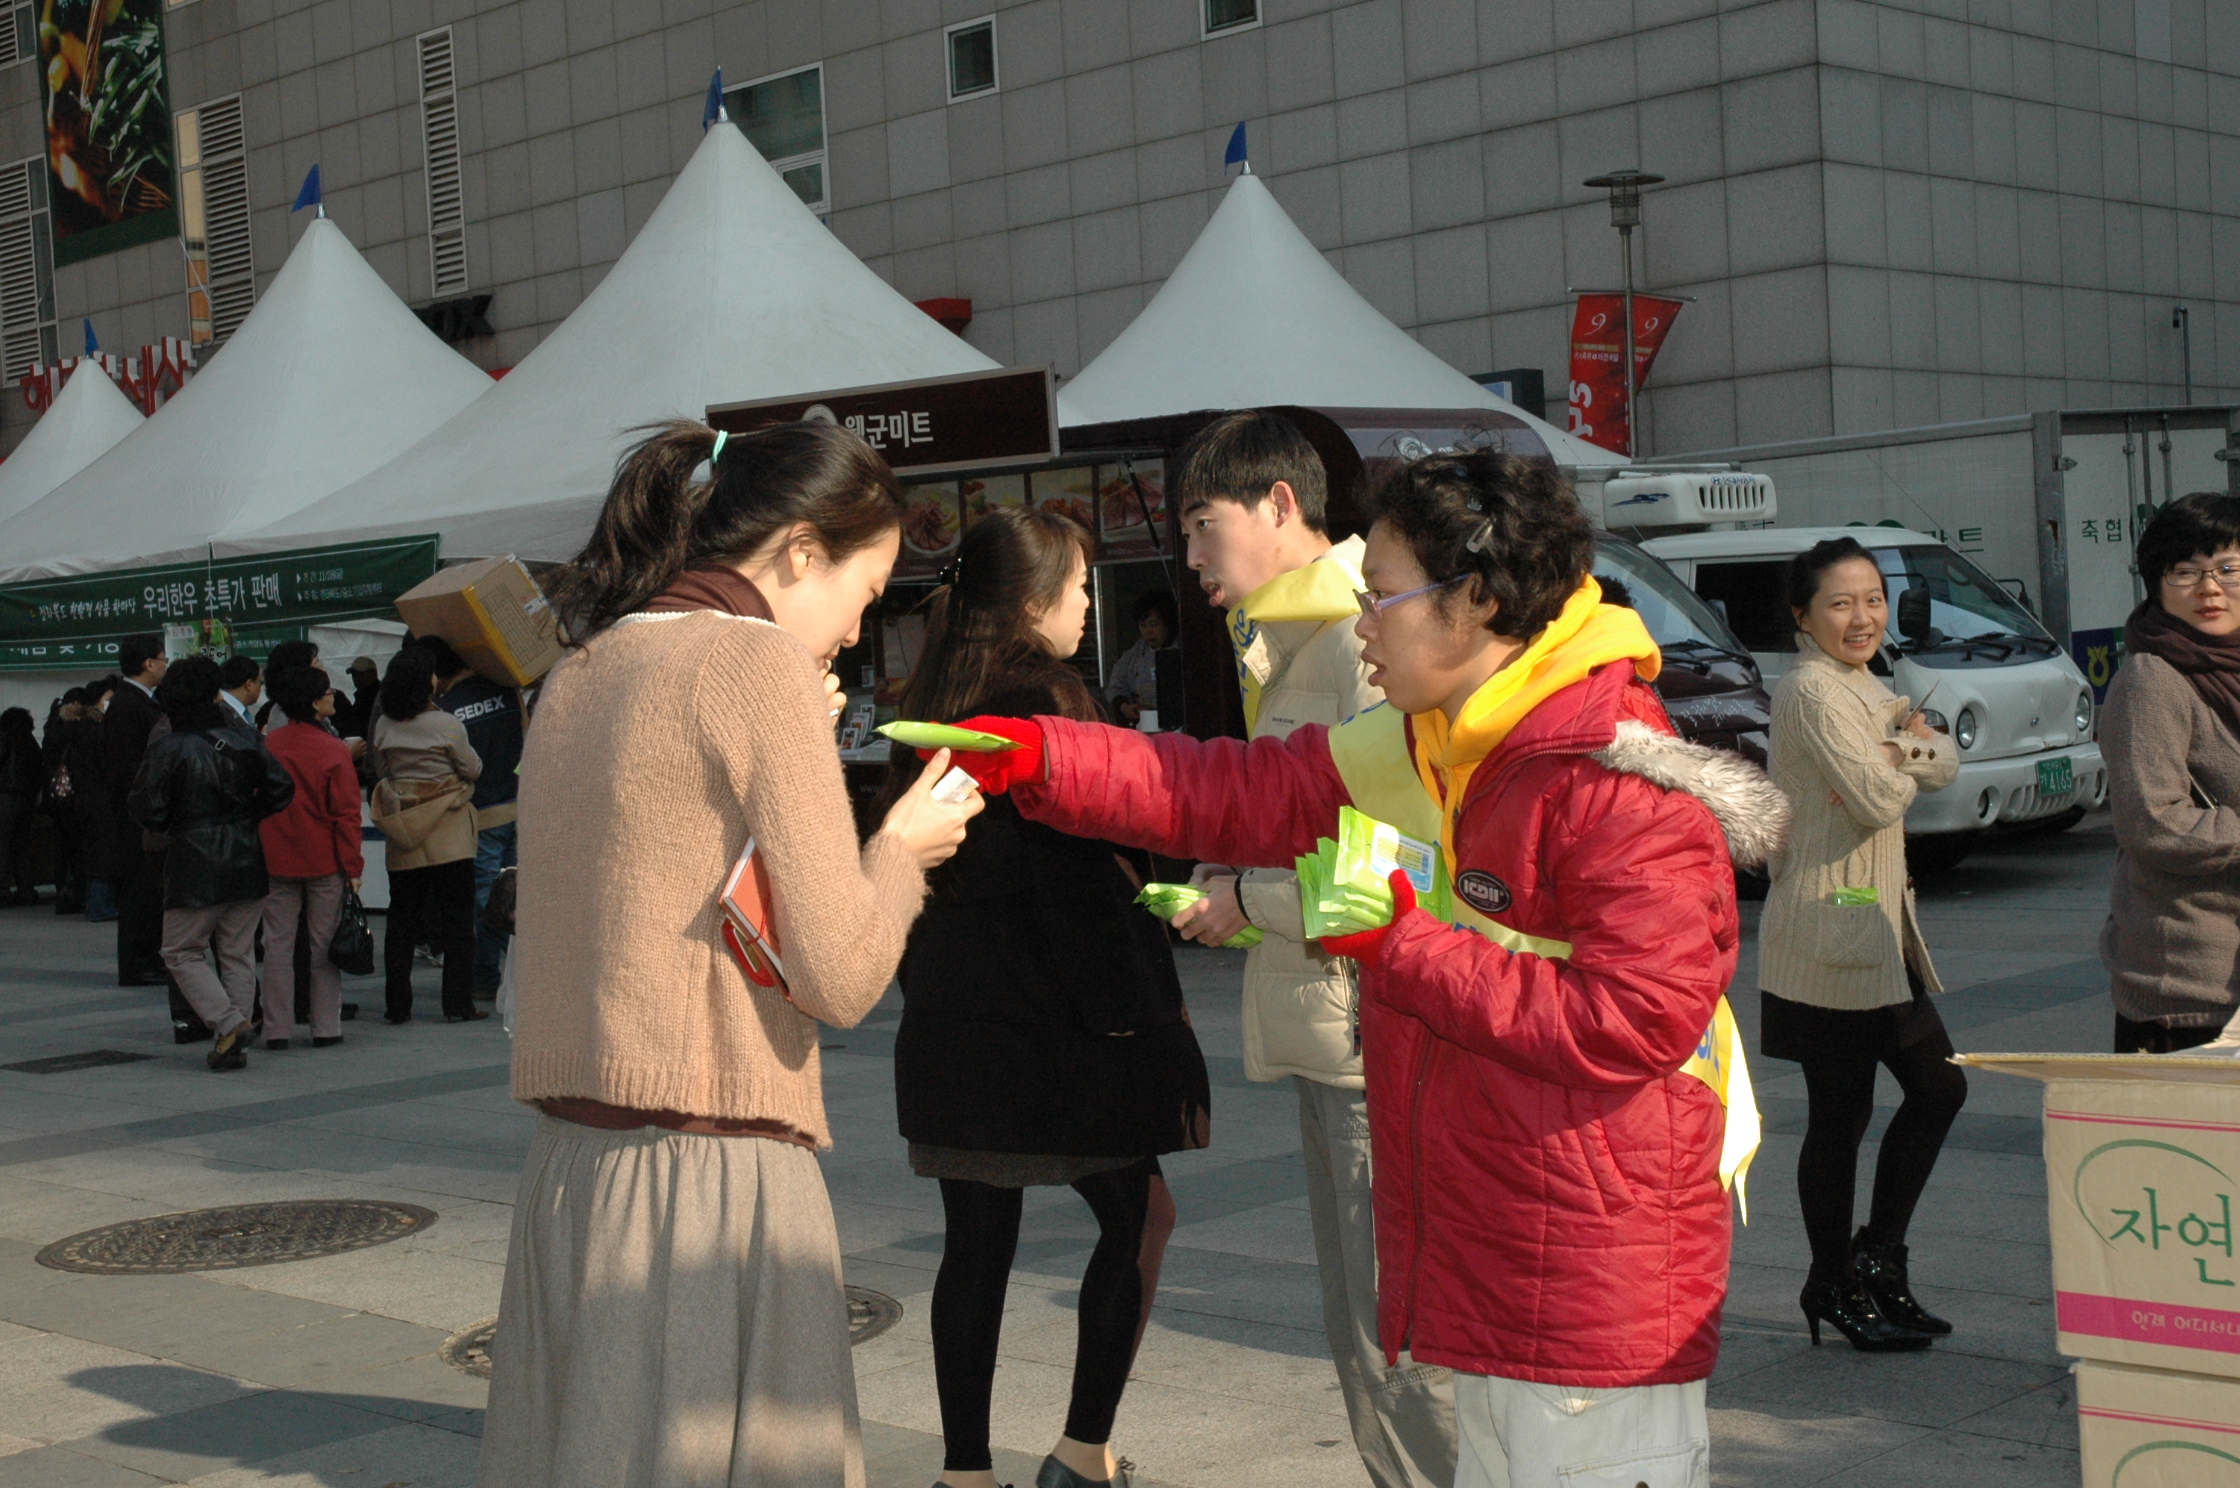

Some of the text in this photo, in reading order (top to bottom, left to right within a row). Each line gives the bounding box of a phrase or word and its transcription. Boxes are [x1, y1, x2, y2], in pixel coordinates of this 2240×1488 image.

[2081, 518, 2122, 544] 축협
[143, 582, 198, 619] 우리한우
[204, 576, 246, 612] 초특가
[251, 572, 282, 609] 판매
[454, 695, 505, 721] SEDEX
[2109, 1186, 2236, 1287] 자연
